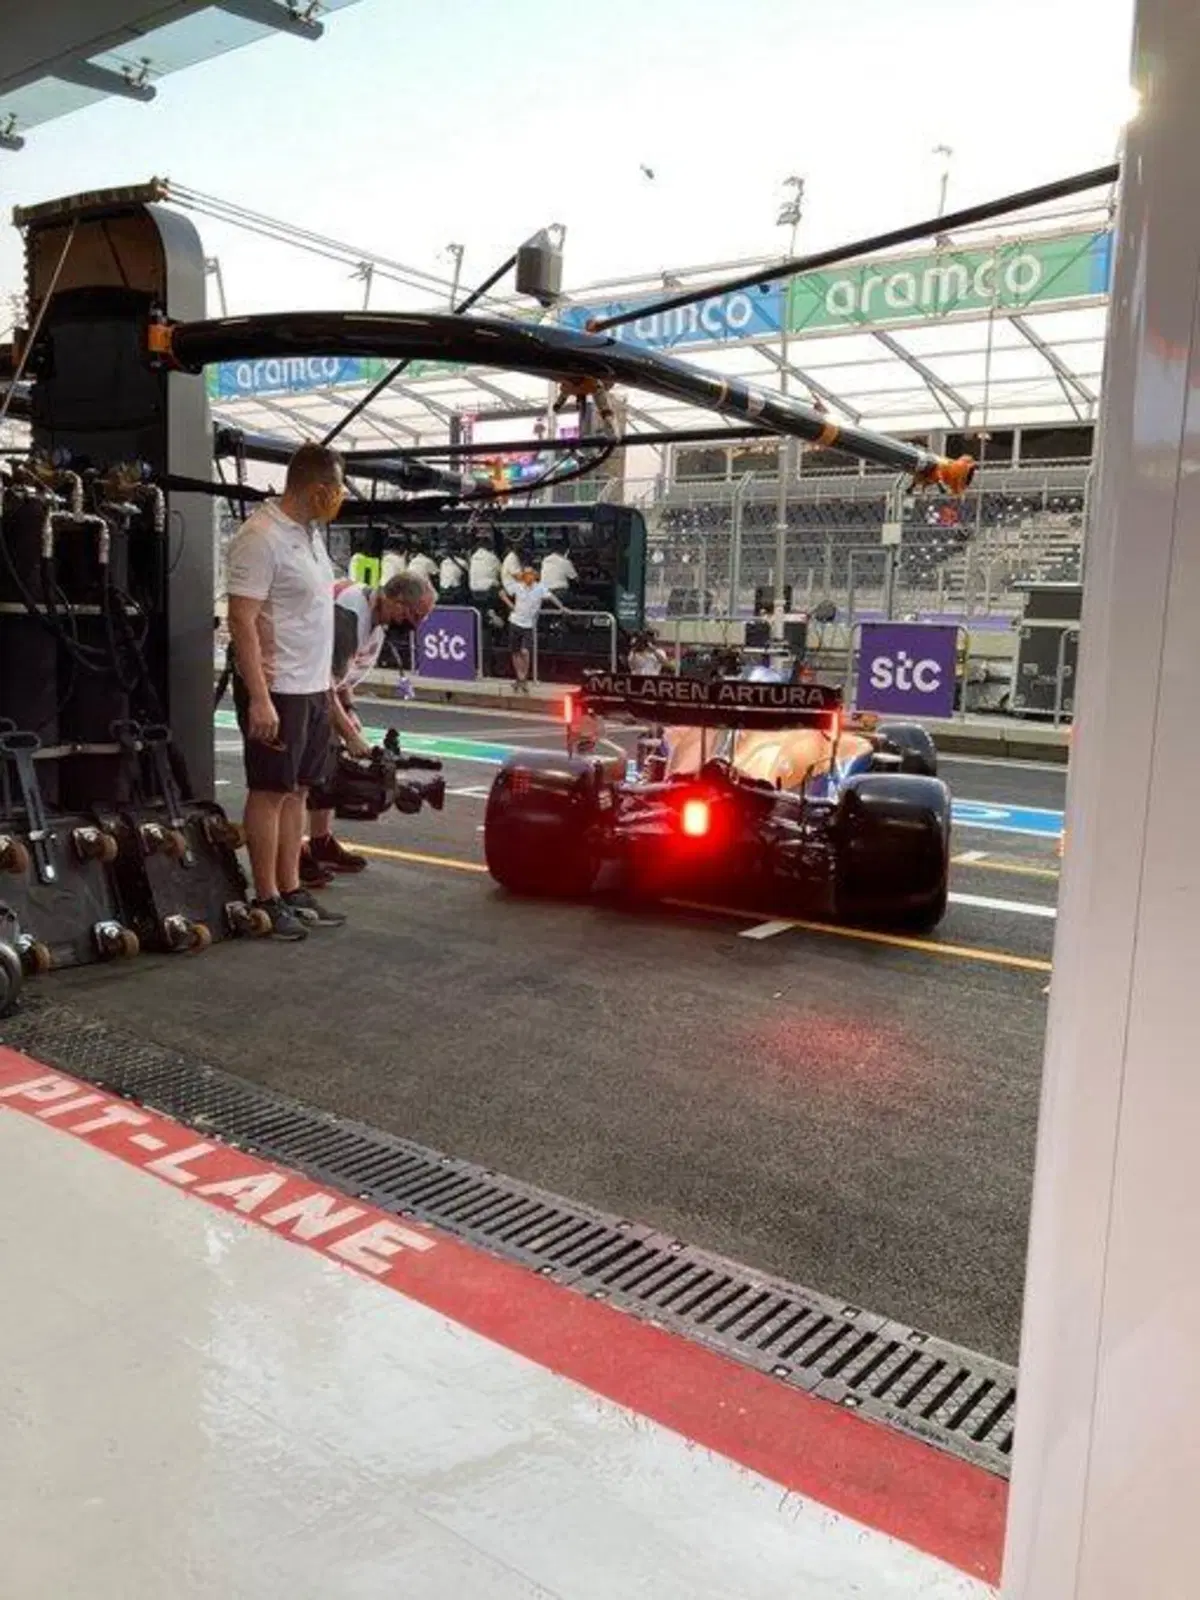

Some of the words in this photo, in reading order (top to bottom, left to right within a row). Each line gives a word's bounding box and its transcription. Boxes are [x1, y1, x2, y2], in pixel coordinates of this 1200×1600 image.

[825, 253, 1042, 316] aramco
[237, 357, 339, 388] aramco
[424, 628, 467, 661] stc
[869, 650, 942, 692] stc
[589, 675, 710, 702] McLAREN
[718, 684, 825, 707] ARTURA
[0, 1075, 438, 1275] PIT-LANE
